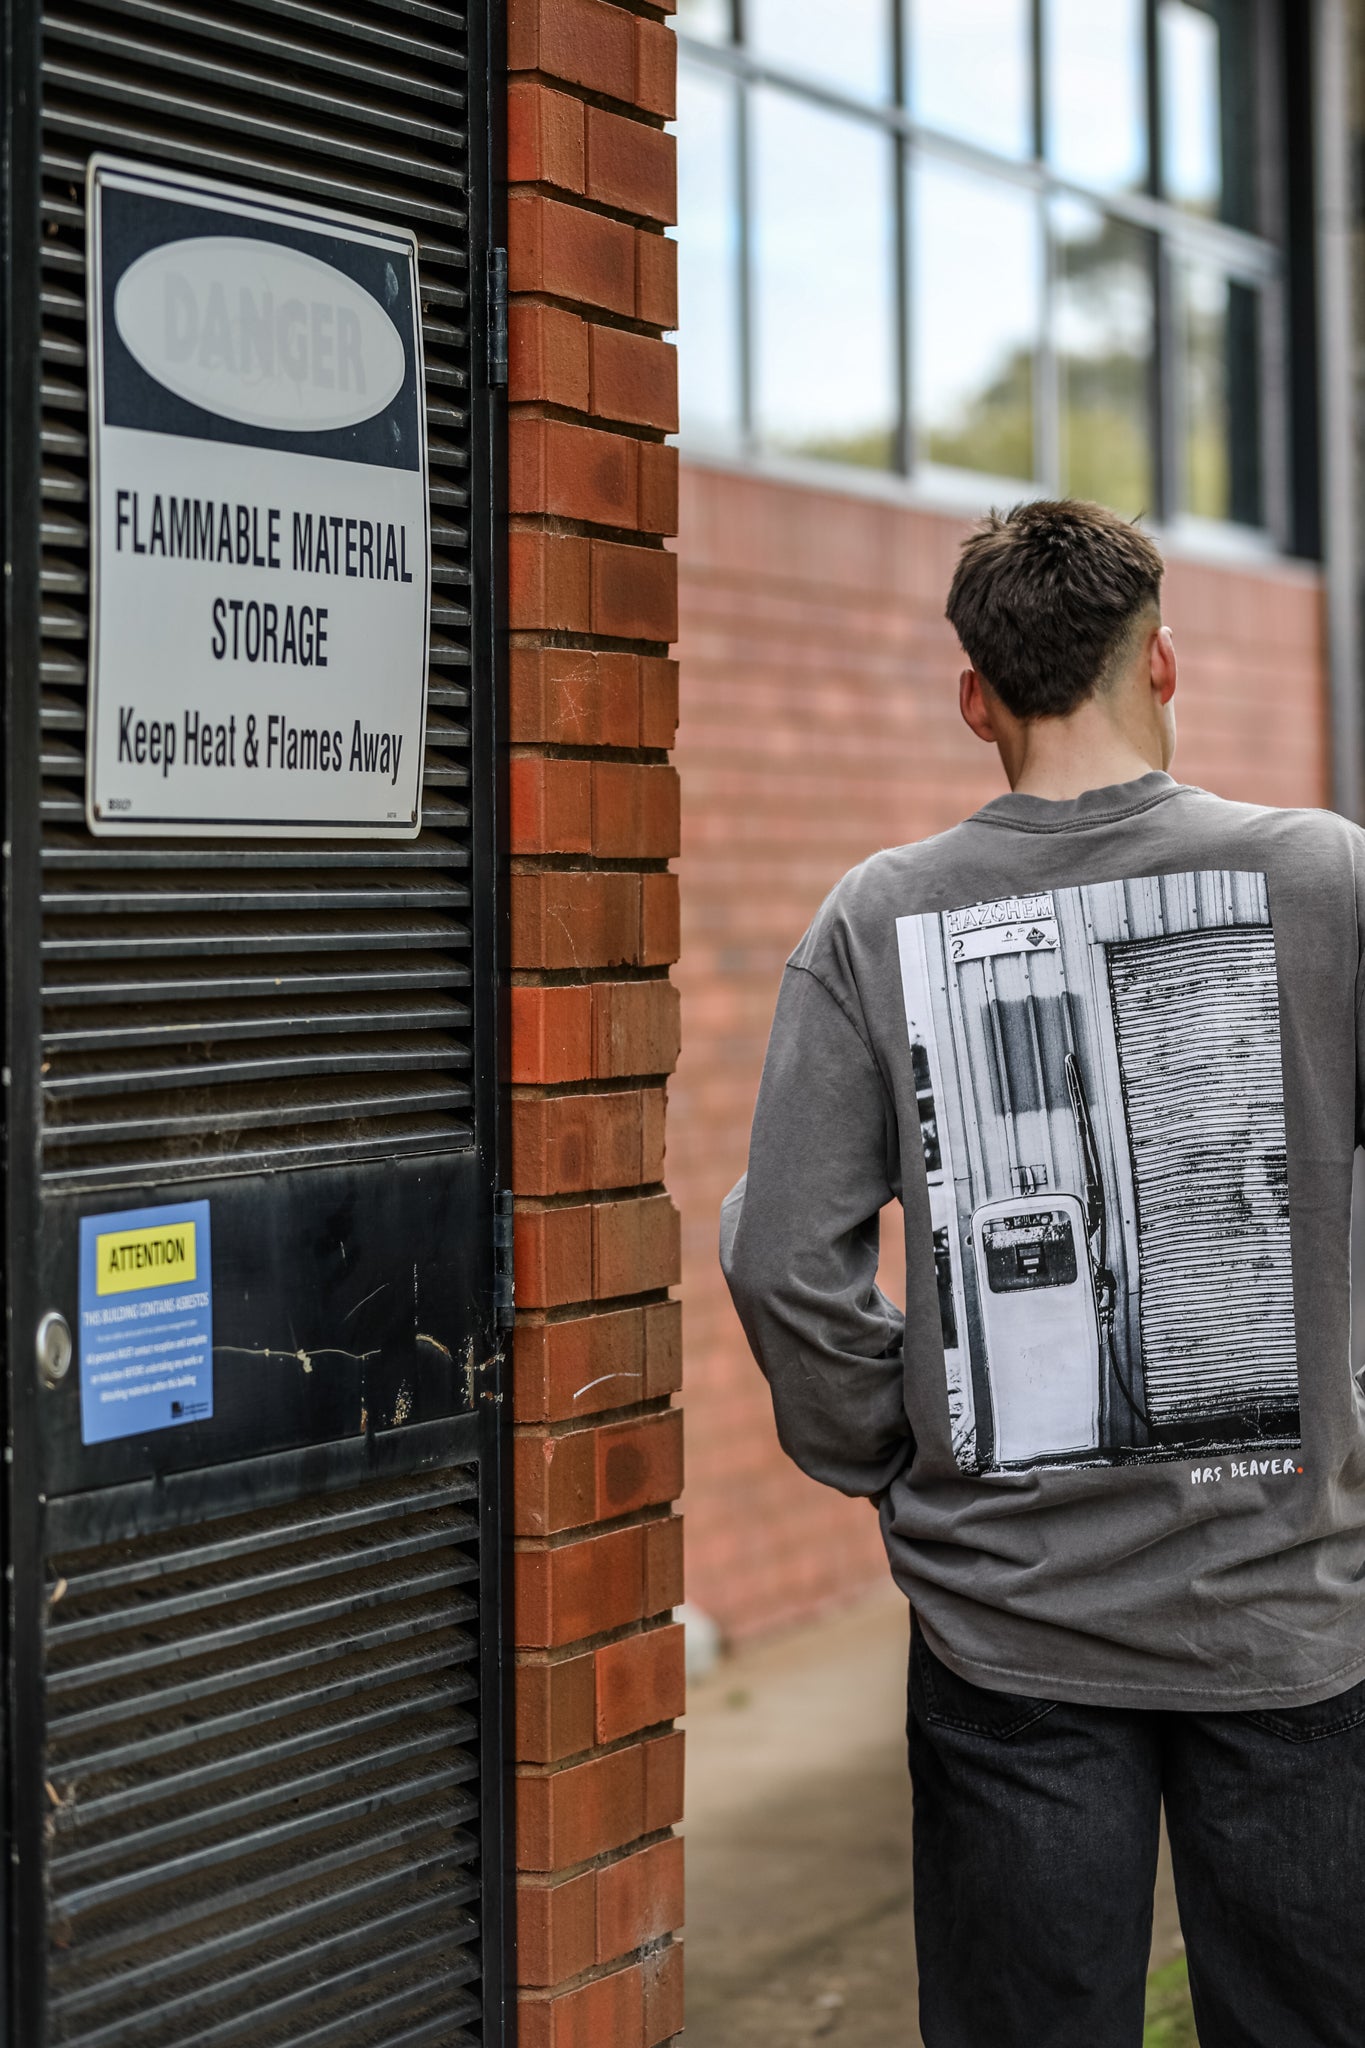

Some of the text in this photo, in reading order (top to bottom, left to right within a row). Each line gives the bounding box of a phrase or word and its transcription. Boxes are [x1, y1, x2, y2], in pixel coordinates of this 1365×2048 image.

[163, 270, 367, 396] DANGER
[116, 488, 412, 583] FLAMMABLE MATERIAL
[212, 597, 328, 667] STORAGE
[118, 706, 402, 785] Keep Heat & Flames Away
[947, 896, 1055, 934] HAZCHEM
[951, 939, 966, 959] 2
[108, 1237, 185, 1274] ATTENTION
[1191, 1466, 1222, 1484] MRS
